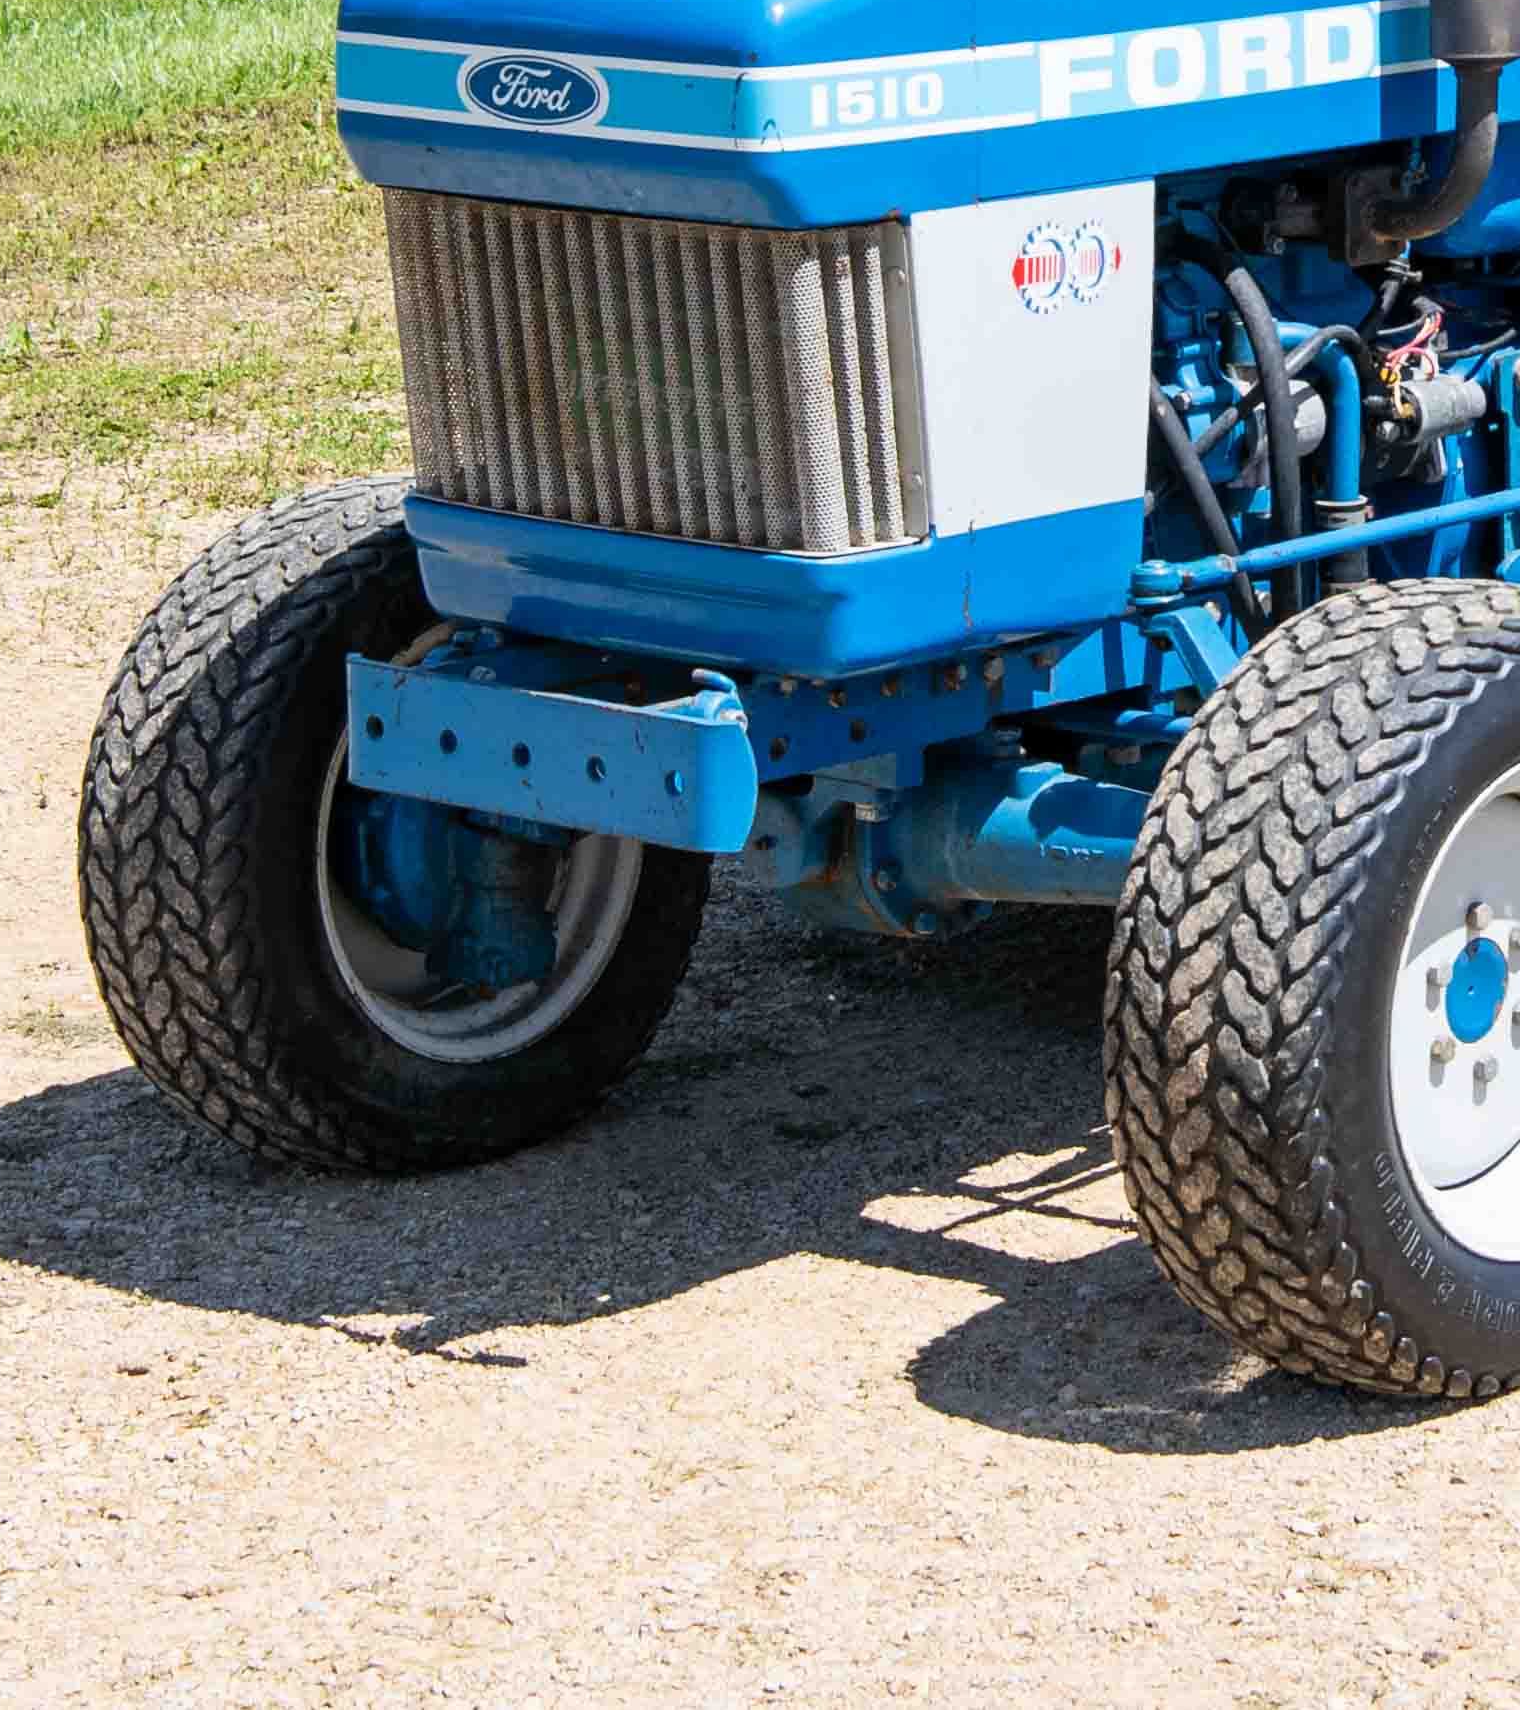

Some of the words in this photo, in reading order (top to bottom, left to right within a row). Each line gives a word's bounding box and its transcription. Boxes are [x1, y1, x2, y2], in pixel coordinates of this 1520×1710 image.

[490, 62, 571, 114] Ford
[1038, 6, 1374, 119] FORD
[810, 70, 945, 130] 1510
